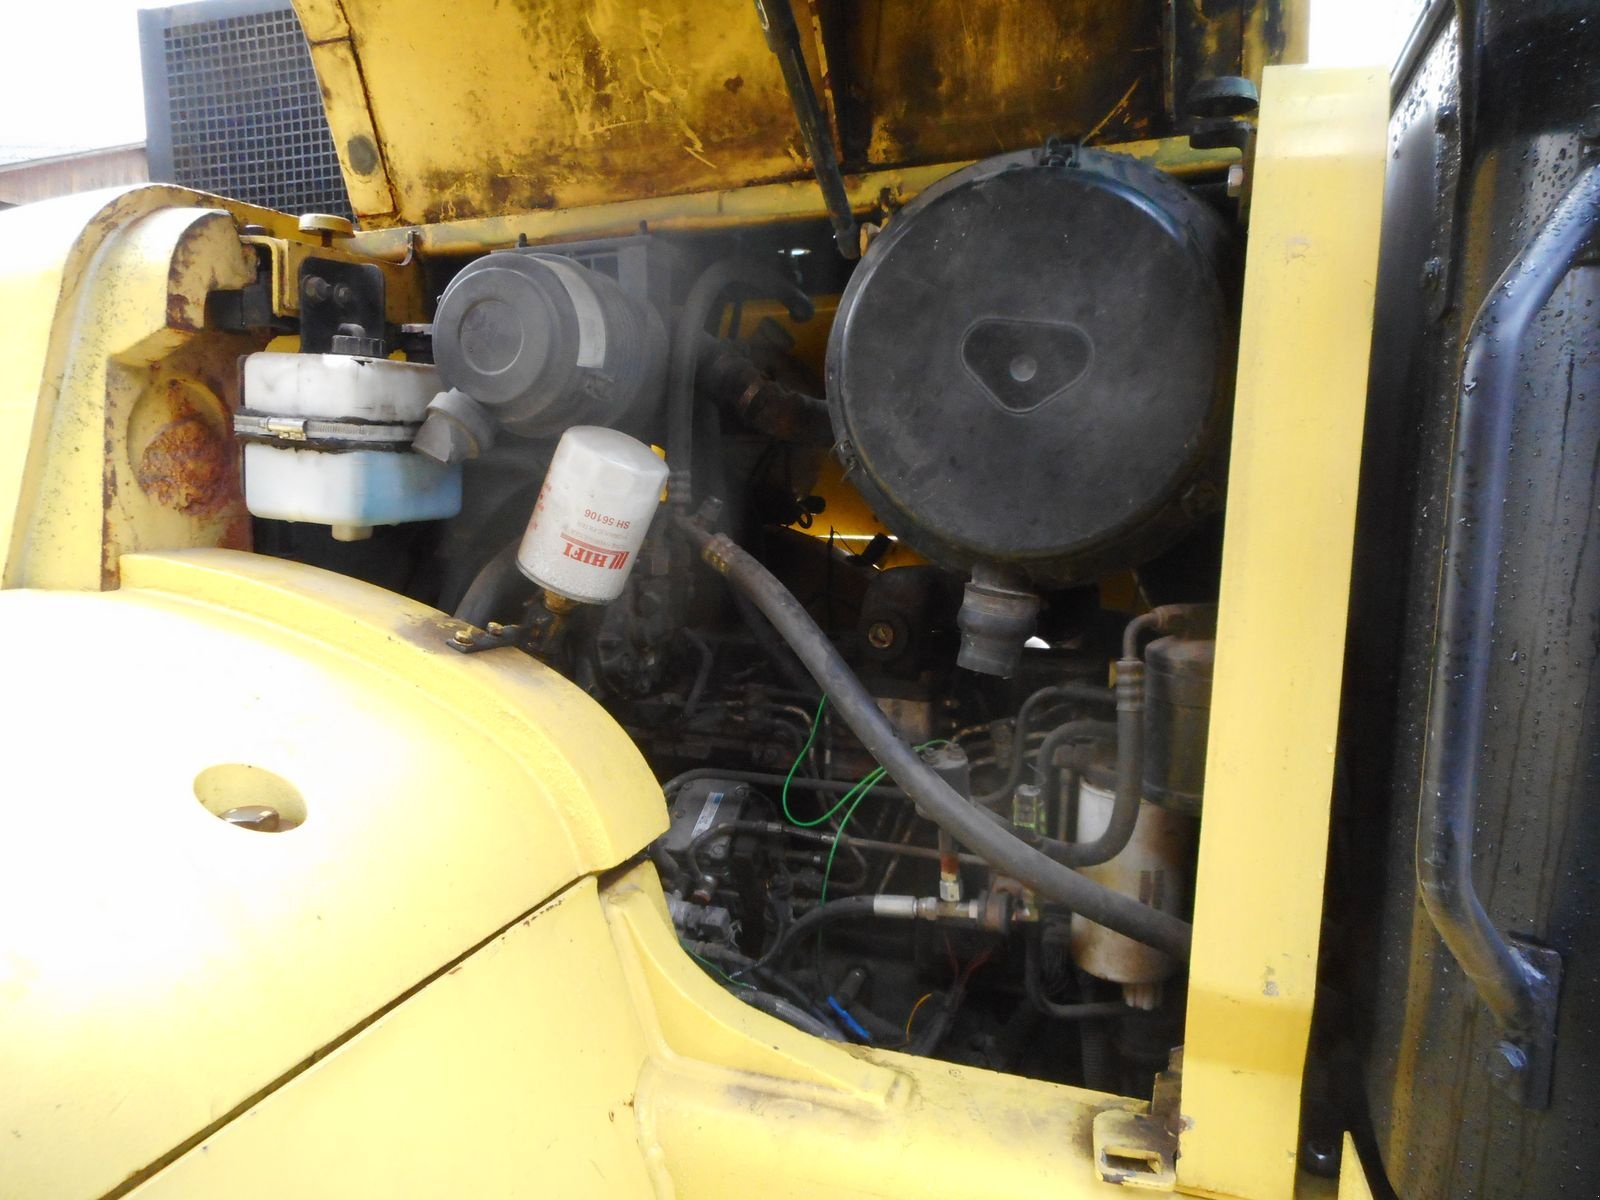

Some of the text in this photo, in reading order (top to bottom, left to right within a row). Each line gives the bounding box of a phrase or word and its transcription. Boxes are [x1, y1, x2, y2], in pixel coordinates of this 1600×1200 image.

[584, 509, 631, 529] SH 56106
[563, 543, 608, 568] HIFI
